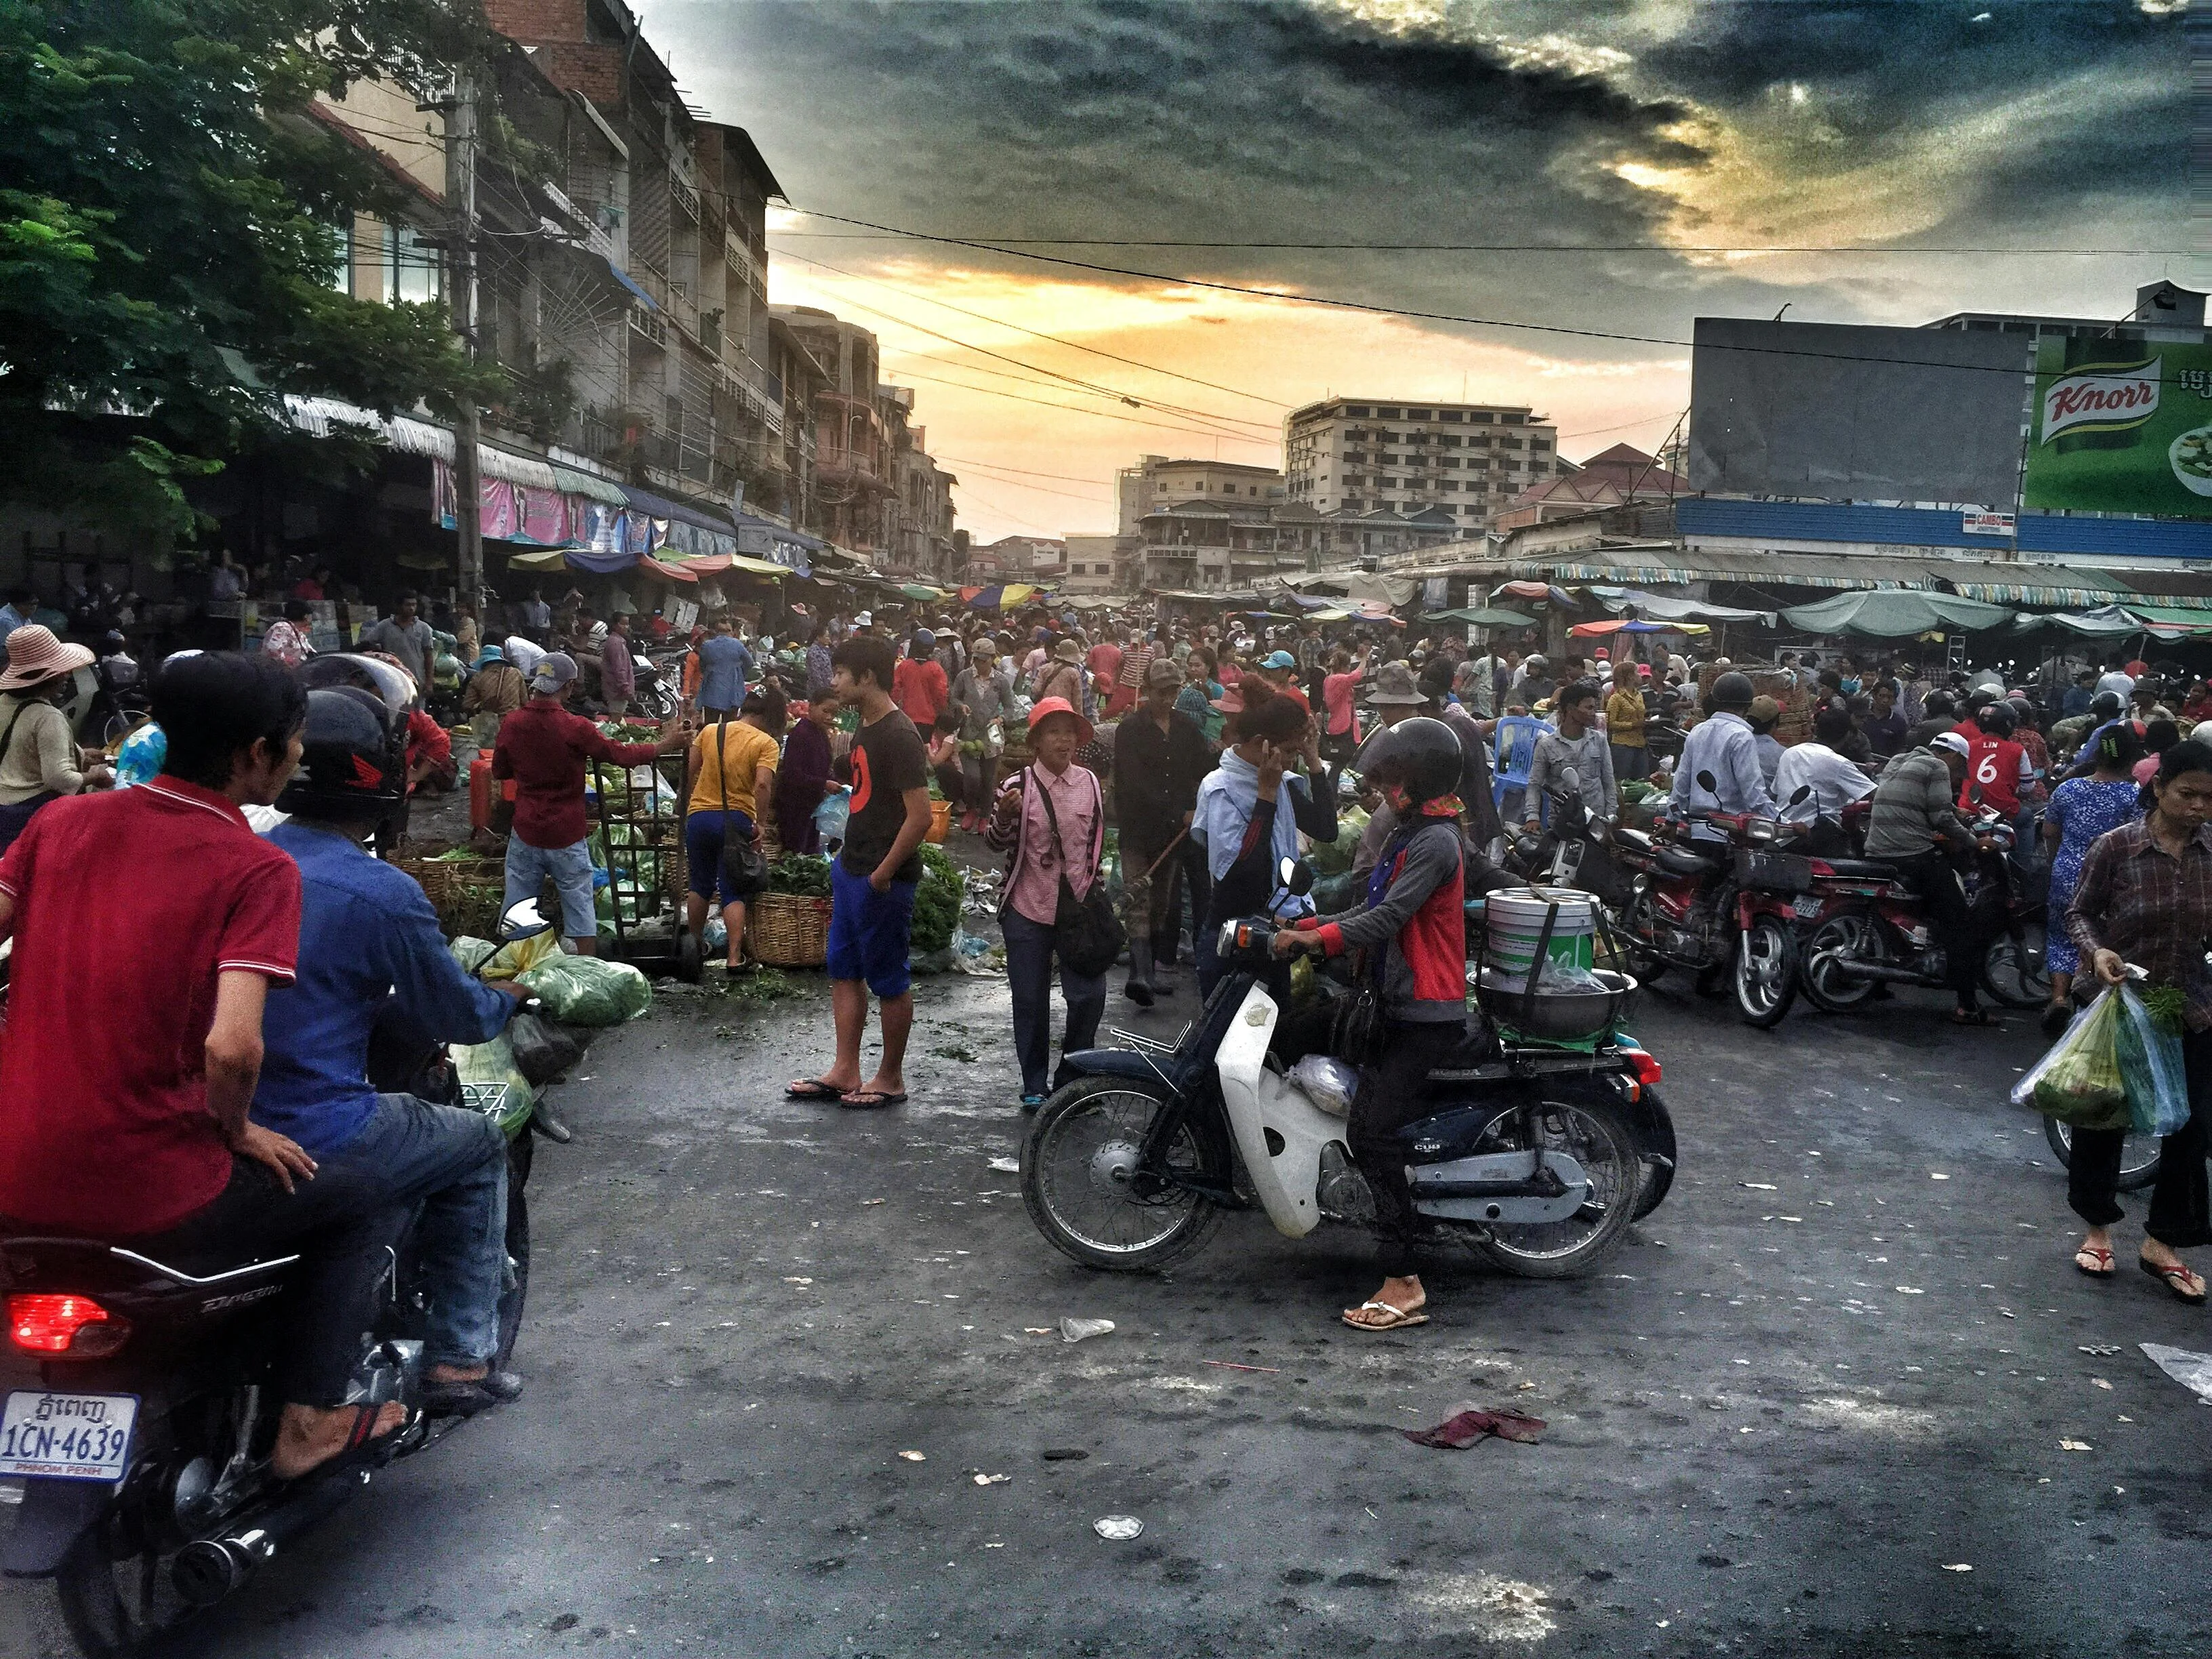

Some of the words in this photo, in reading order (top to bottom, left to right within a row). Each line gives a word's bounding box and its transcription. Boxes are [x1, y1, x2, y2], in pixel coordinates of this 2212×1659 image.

[2048, 382, 2154, 422] Knorr
[1977, 753, 1997, 783] 6
[2, 1425, 125, 1460] 1CN-4639
[15, 1463, 62, 1473] PHNOM
[67, 1465, 101, 1475] PENH
